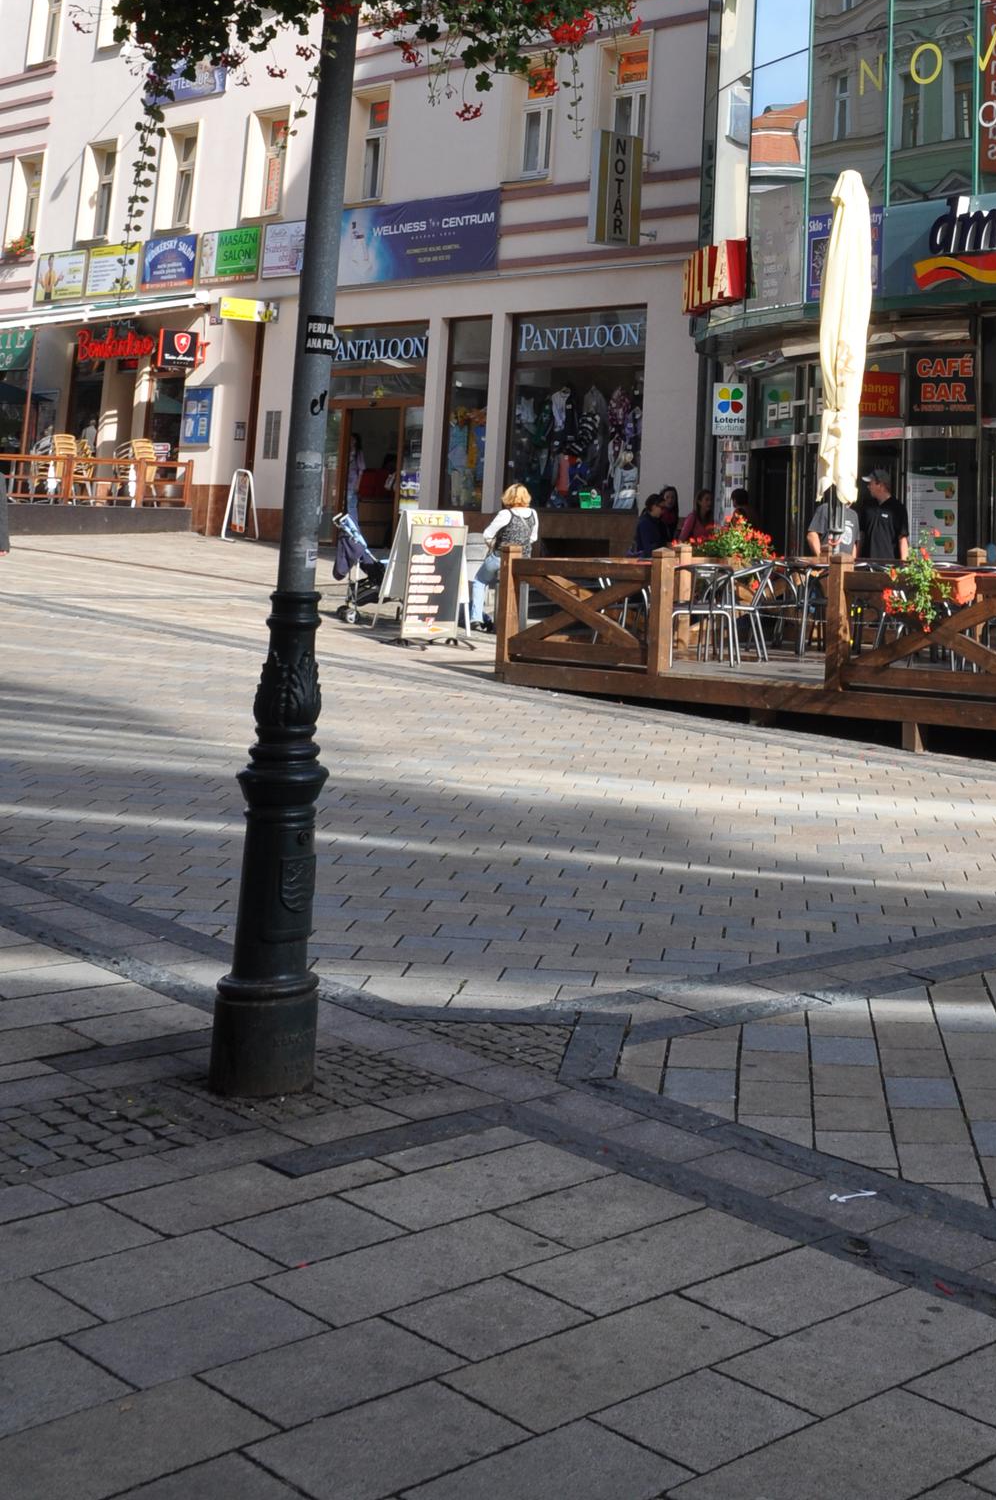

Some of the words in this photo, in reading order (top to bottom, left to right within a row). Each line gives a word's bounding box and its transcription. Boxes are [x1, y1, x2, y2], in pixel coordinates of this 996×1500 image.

[372, 221, 427, 237] WELLNESS
[441, 211, 495, 229] CENTRUM
[308, 322, 327, 334] PERU
[519, 322, 641, 352] PANTALOON
[916, 354, 974, 378] CAFÉ
[861, 382, 895, 396] hange
[920, 382, 968, 403] BAR
[714, 415, 745, 424] Loterie
